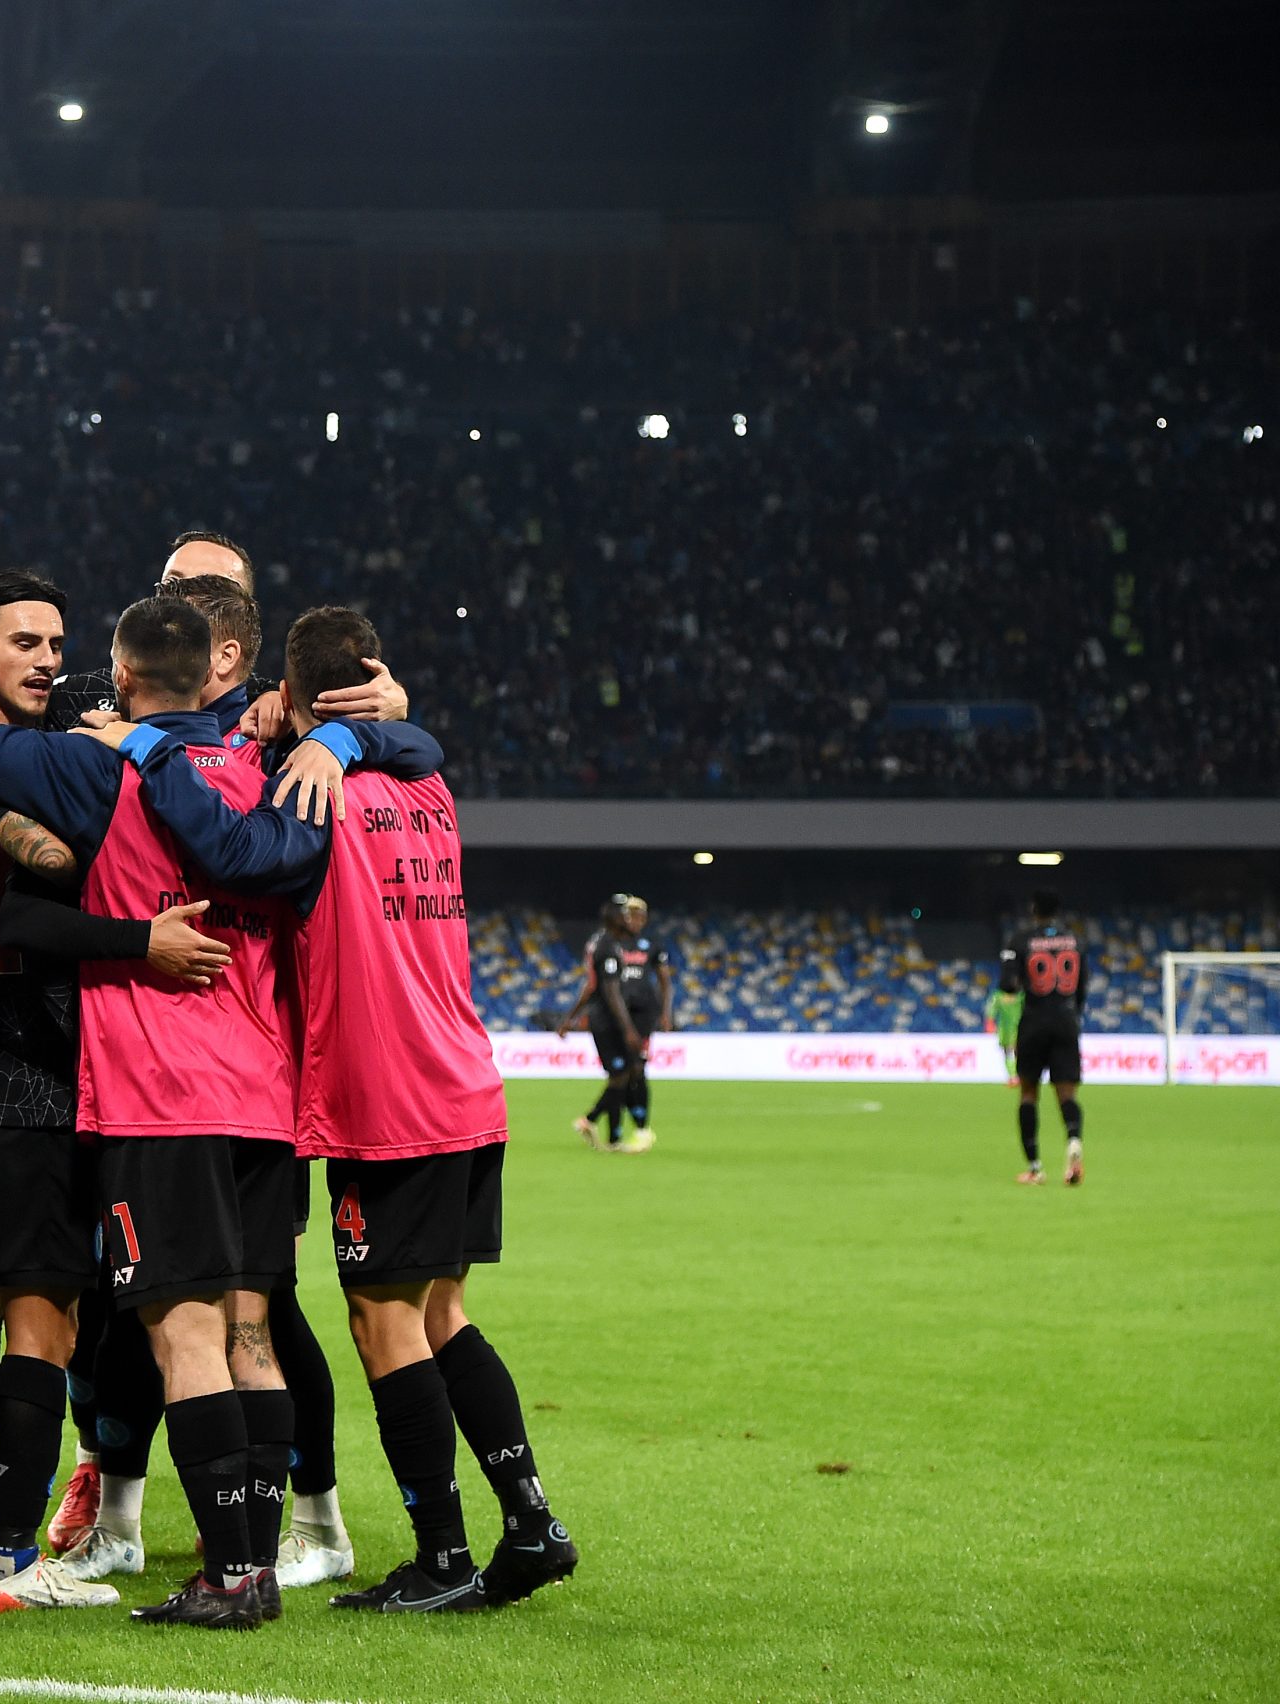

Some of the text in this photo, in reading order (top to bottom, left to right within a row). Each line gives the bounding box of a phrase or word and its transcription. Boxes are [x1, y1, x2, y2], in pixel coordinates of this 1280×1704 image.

[193, 756, 226, 768] SSCN
[410, 858, 429, 883] TU
[1028, 950, 1081, 996] 99
[336, 1182, 366, 1243] 4
[337, 1245, 370, 1262] EA7
[112, 1265, 135, 1287] A7
[488, 1444, 525, 1466] EA7
